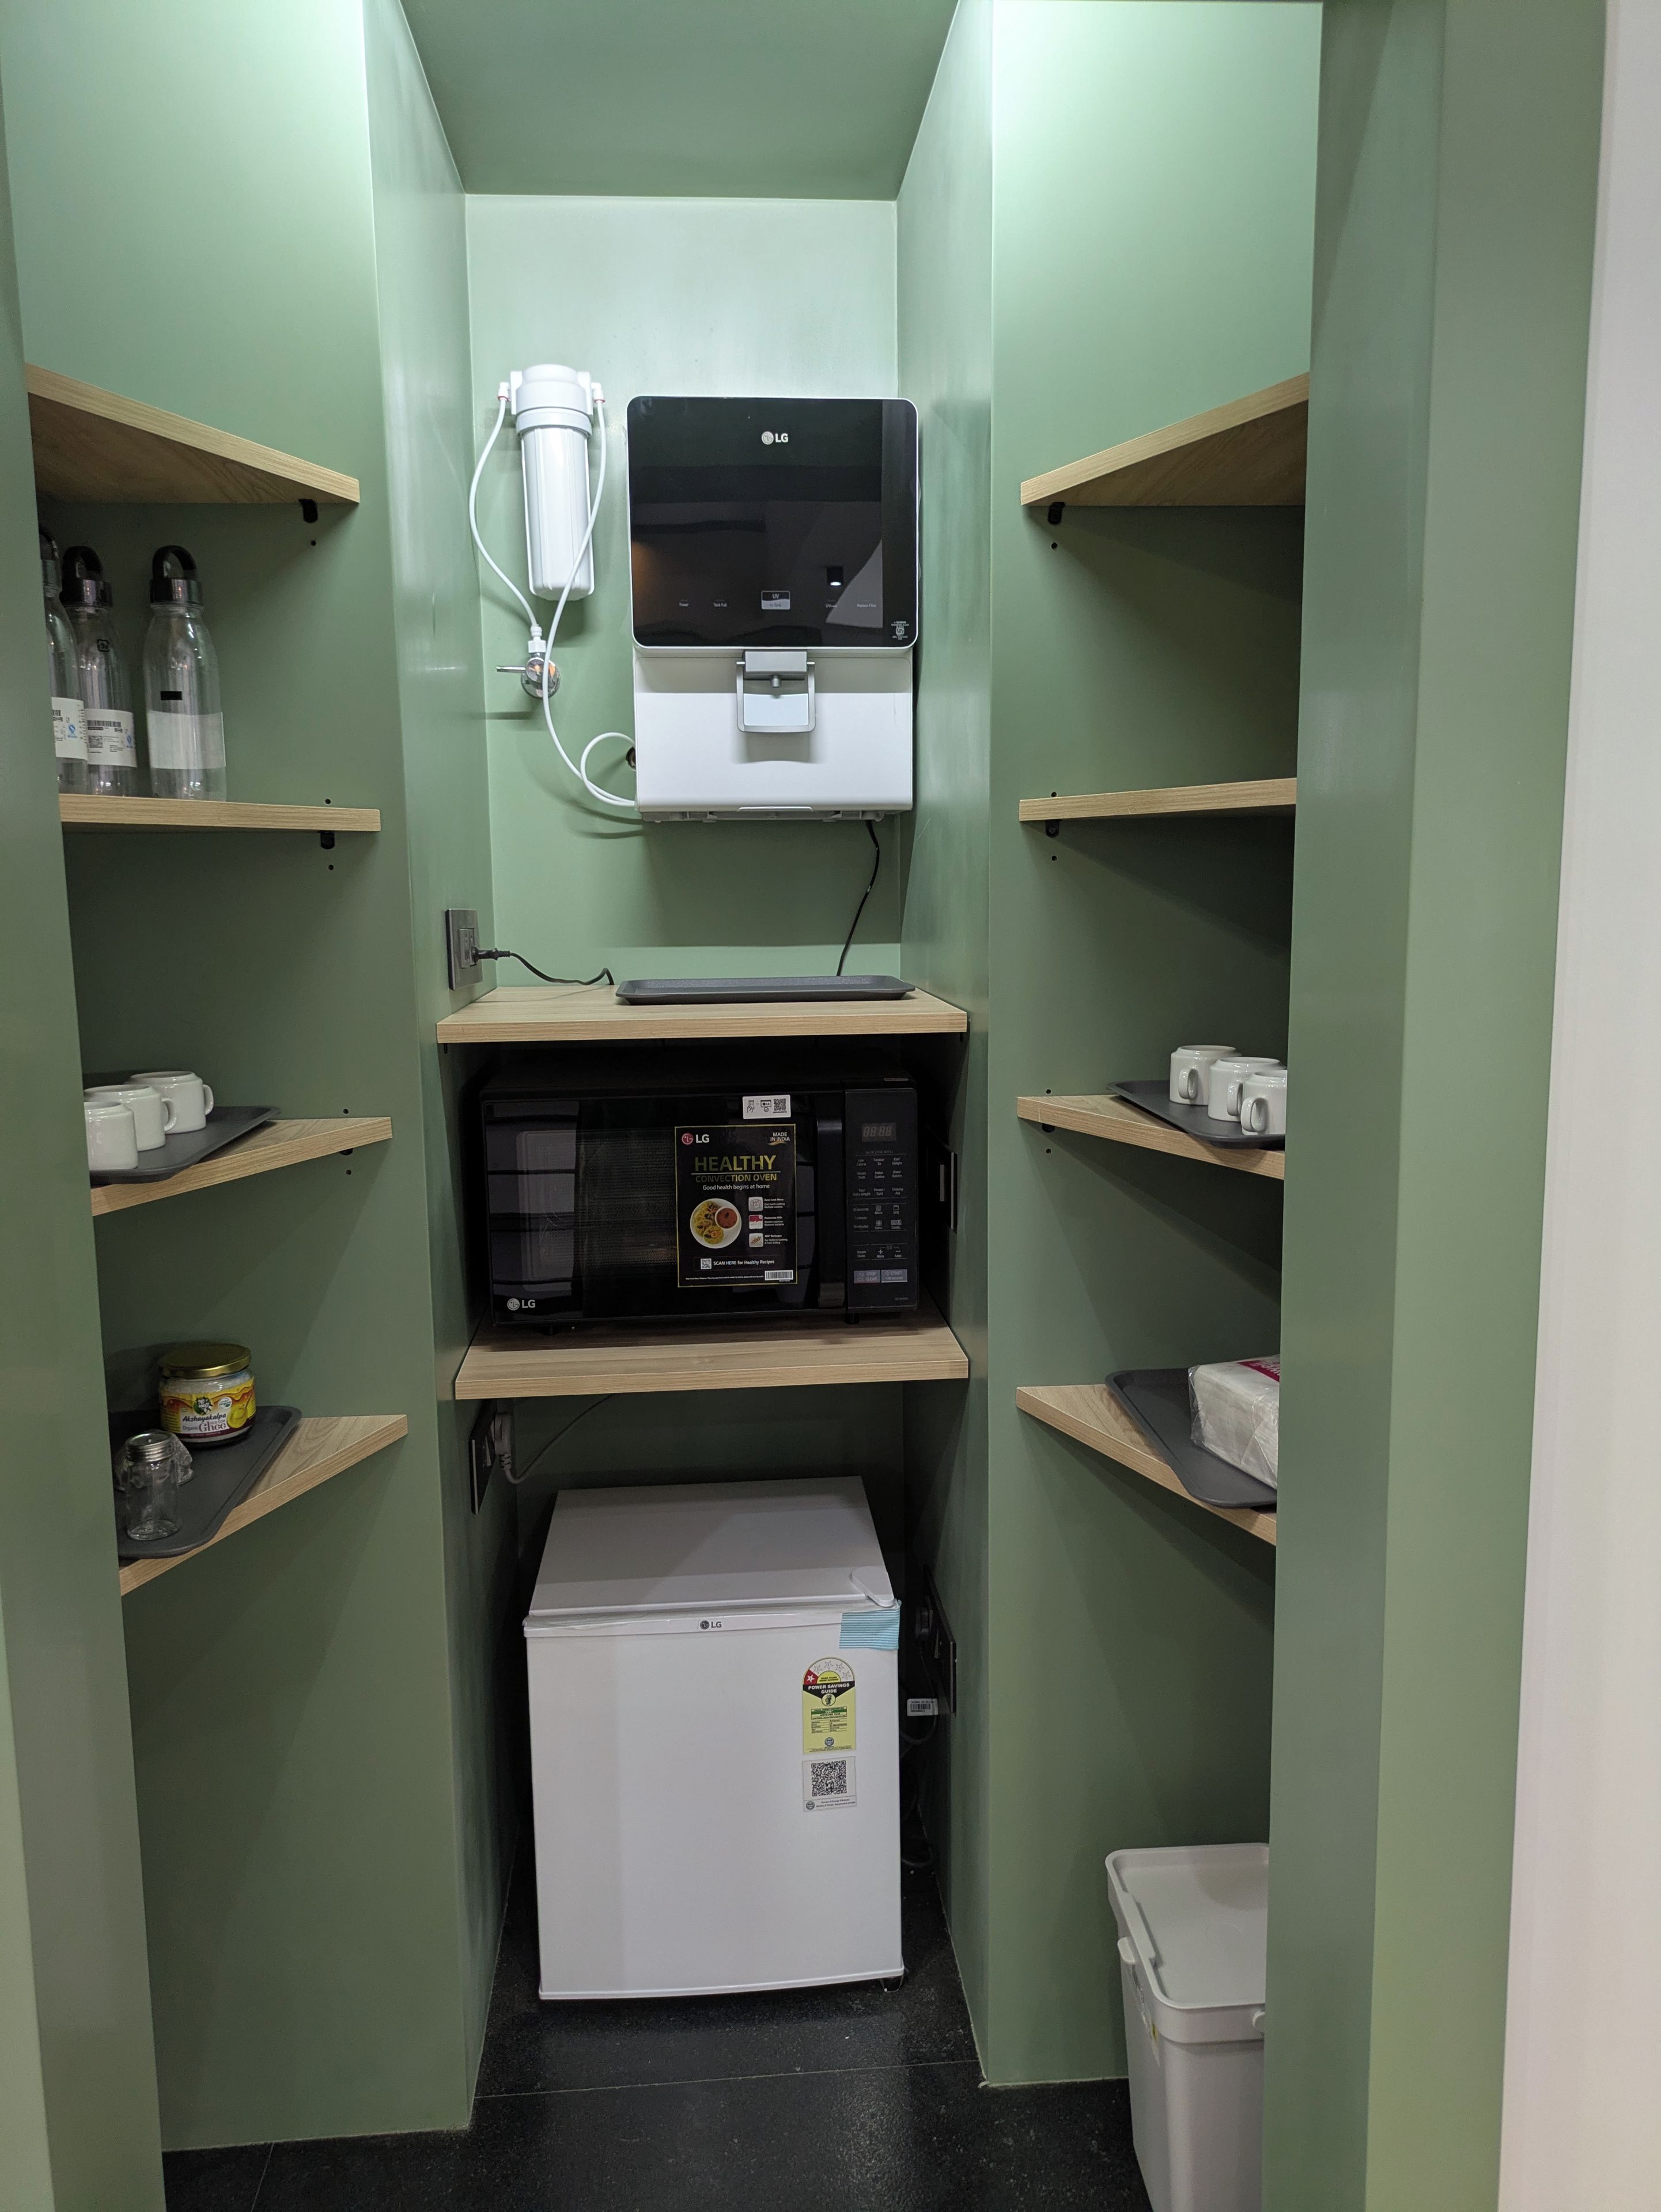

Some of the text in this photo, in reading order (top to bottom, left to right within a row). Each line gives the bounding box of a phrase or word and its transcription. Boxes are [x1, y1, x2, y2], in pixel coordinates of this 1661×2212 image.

[775, 433, 789, 443] LG
[695, 1134, 710, 1143] LG
[695, 1154, 777, 1171] HEALTHY
[695, 1174, 751, 1183] CONVECTION
[521, 1299, 536, 1308] LG
[183, 1412, 226, 1423] Akshayakalpa
[199, 1421, 226, 1432] Ghee
